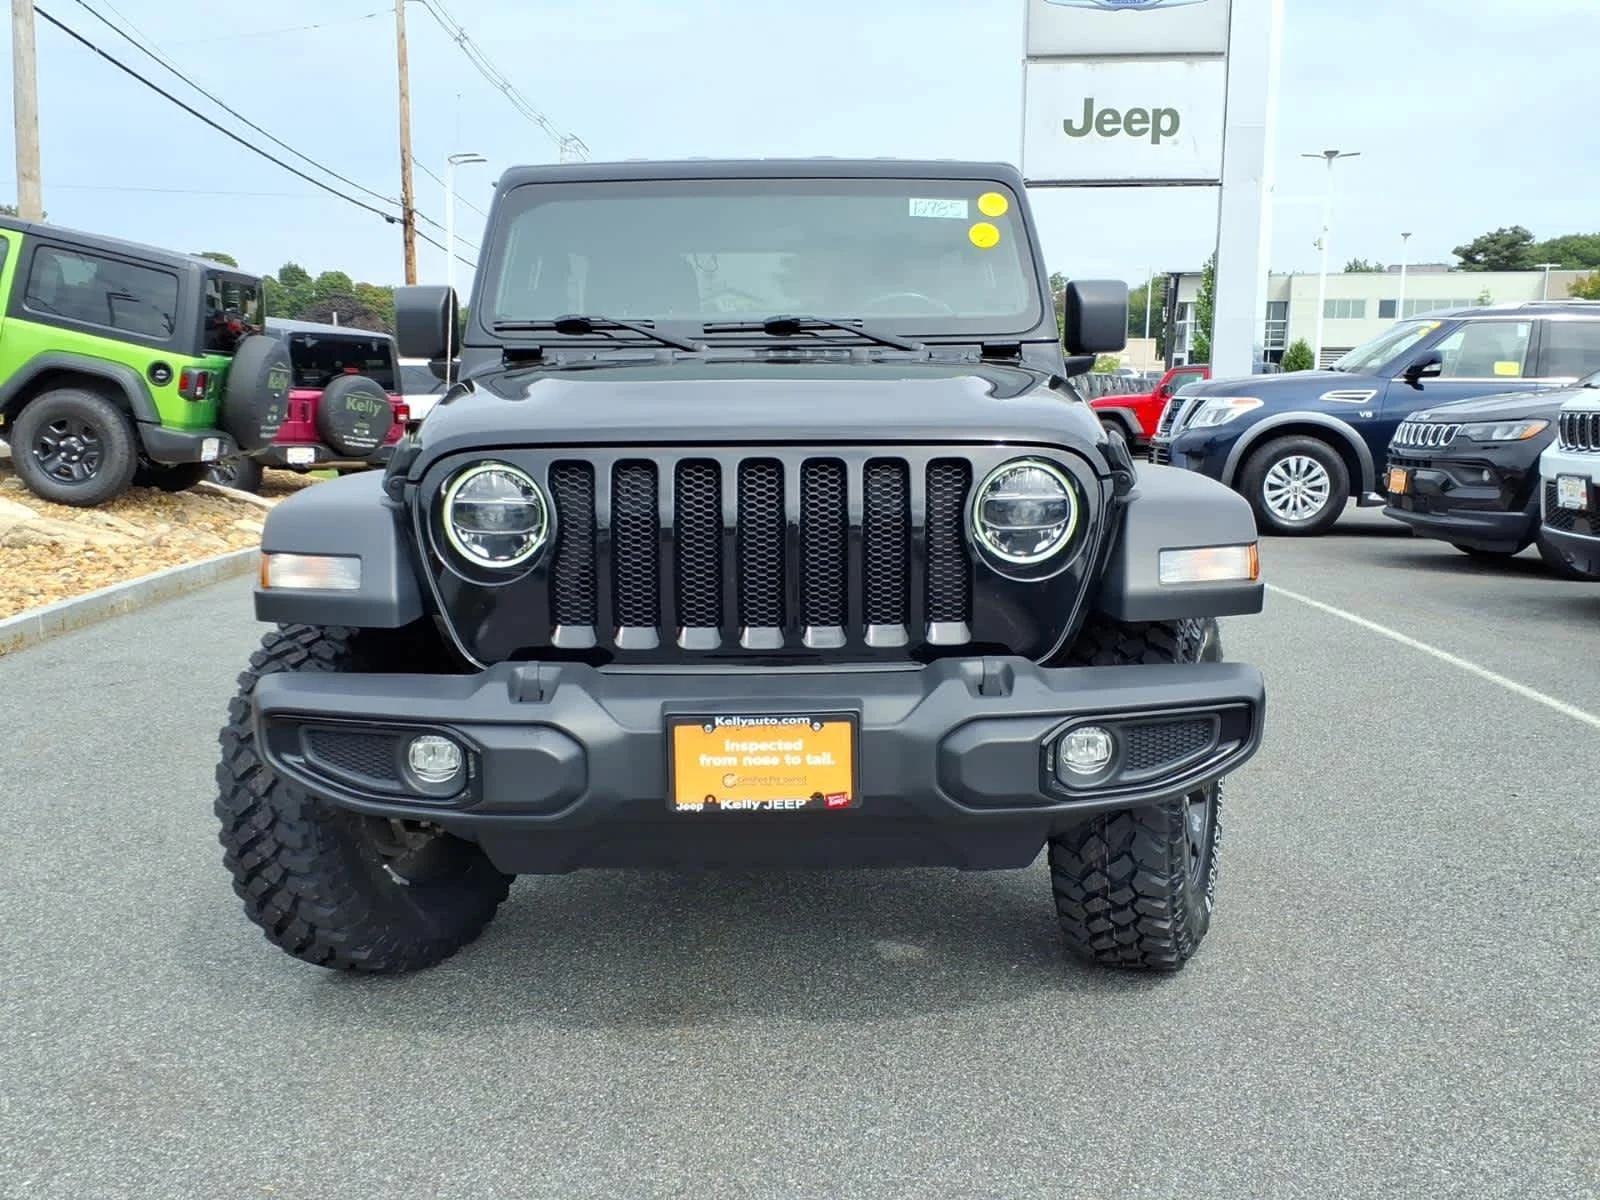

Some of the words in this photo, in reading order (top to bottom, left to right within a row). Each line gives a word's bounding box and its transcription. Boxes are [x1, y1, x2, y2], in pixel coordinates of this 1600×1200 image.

[1063, 97, 1180, 145] Jeep
[346, 396, 382, 417] Kelly
[1359, 410, 1373, 418] V8
[715, 716, 811, 727] Kellyauto.com
[724, 739, 804, 754] Inspected
[699, 754, 738, 767] from
[742, 755, 780, 767] nose
[784, 754, 802, 766] to
[806, 752, 836, 766] tail.
[676, 803, 704, 812] Jeep
[720, 800, 762, 811] Kelly
[763, 800, 807, 810] JEEP
